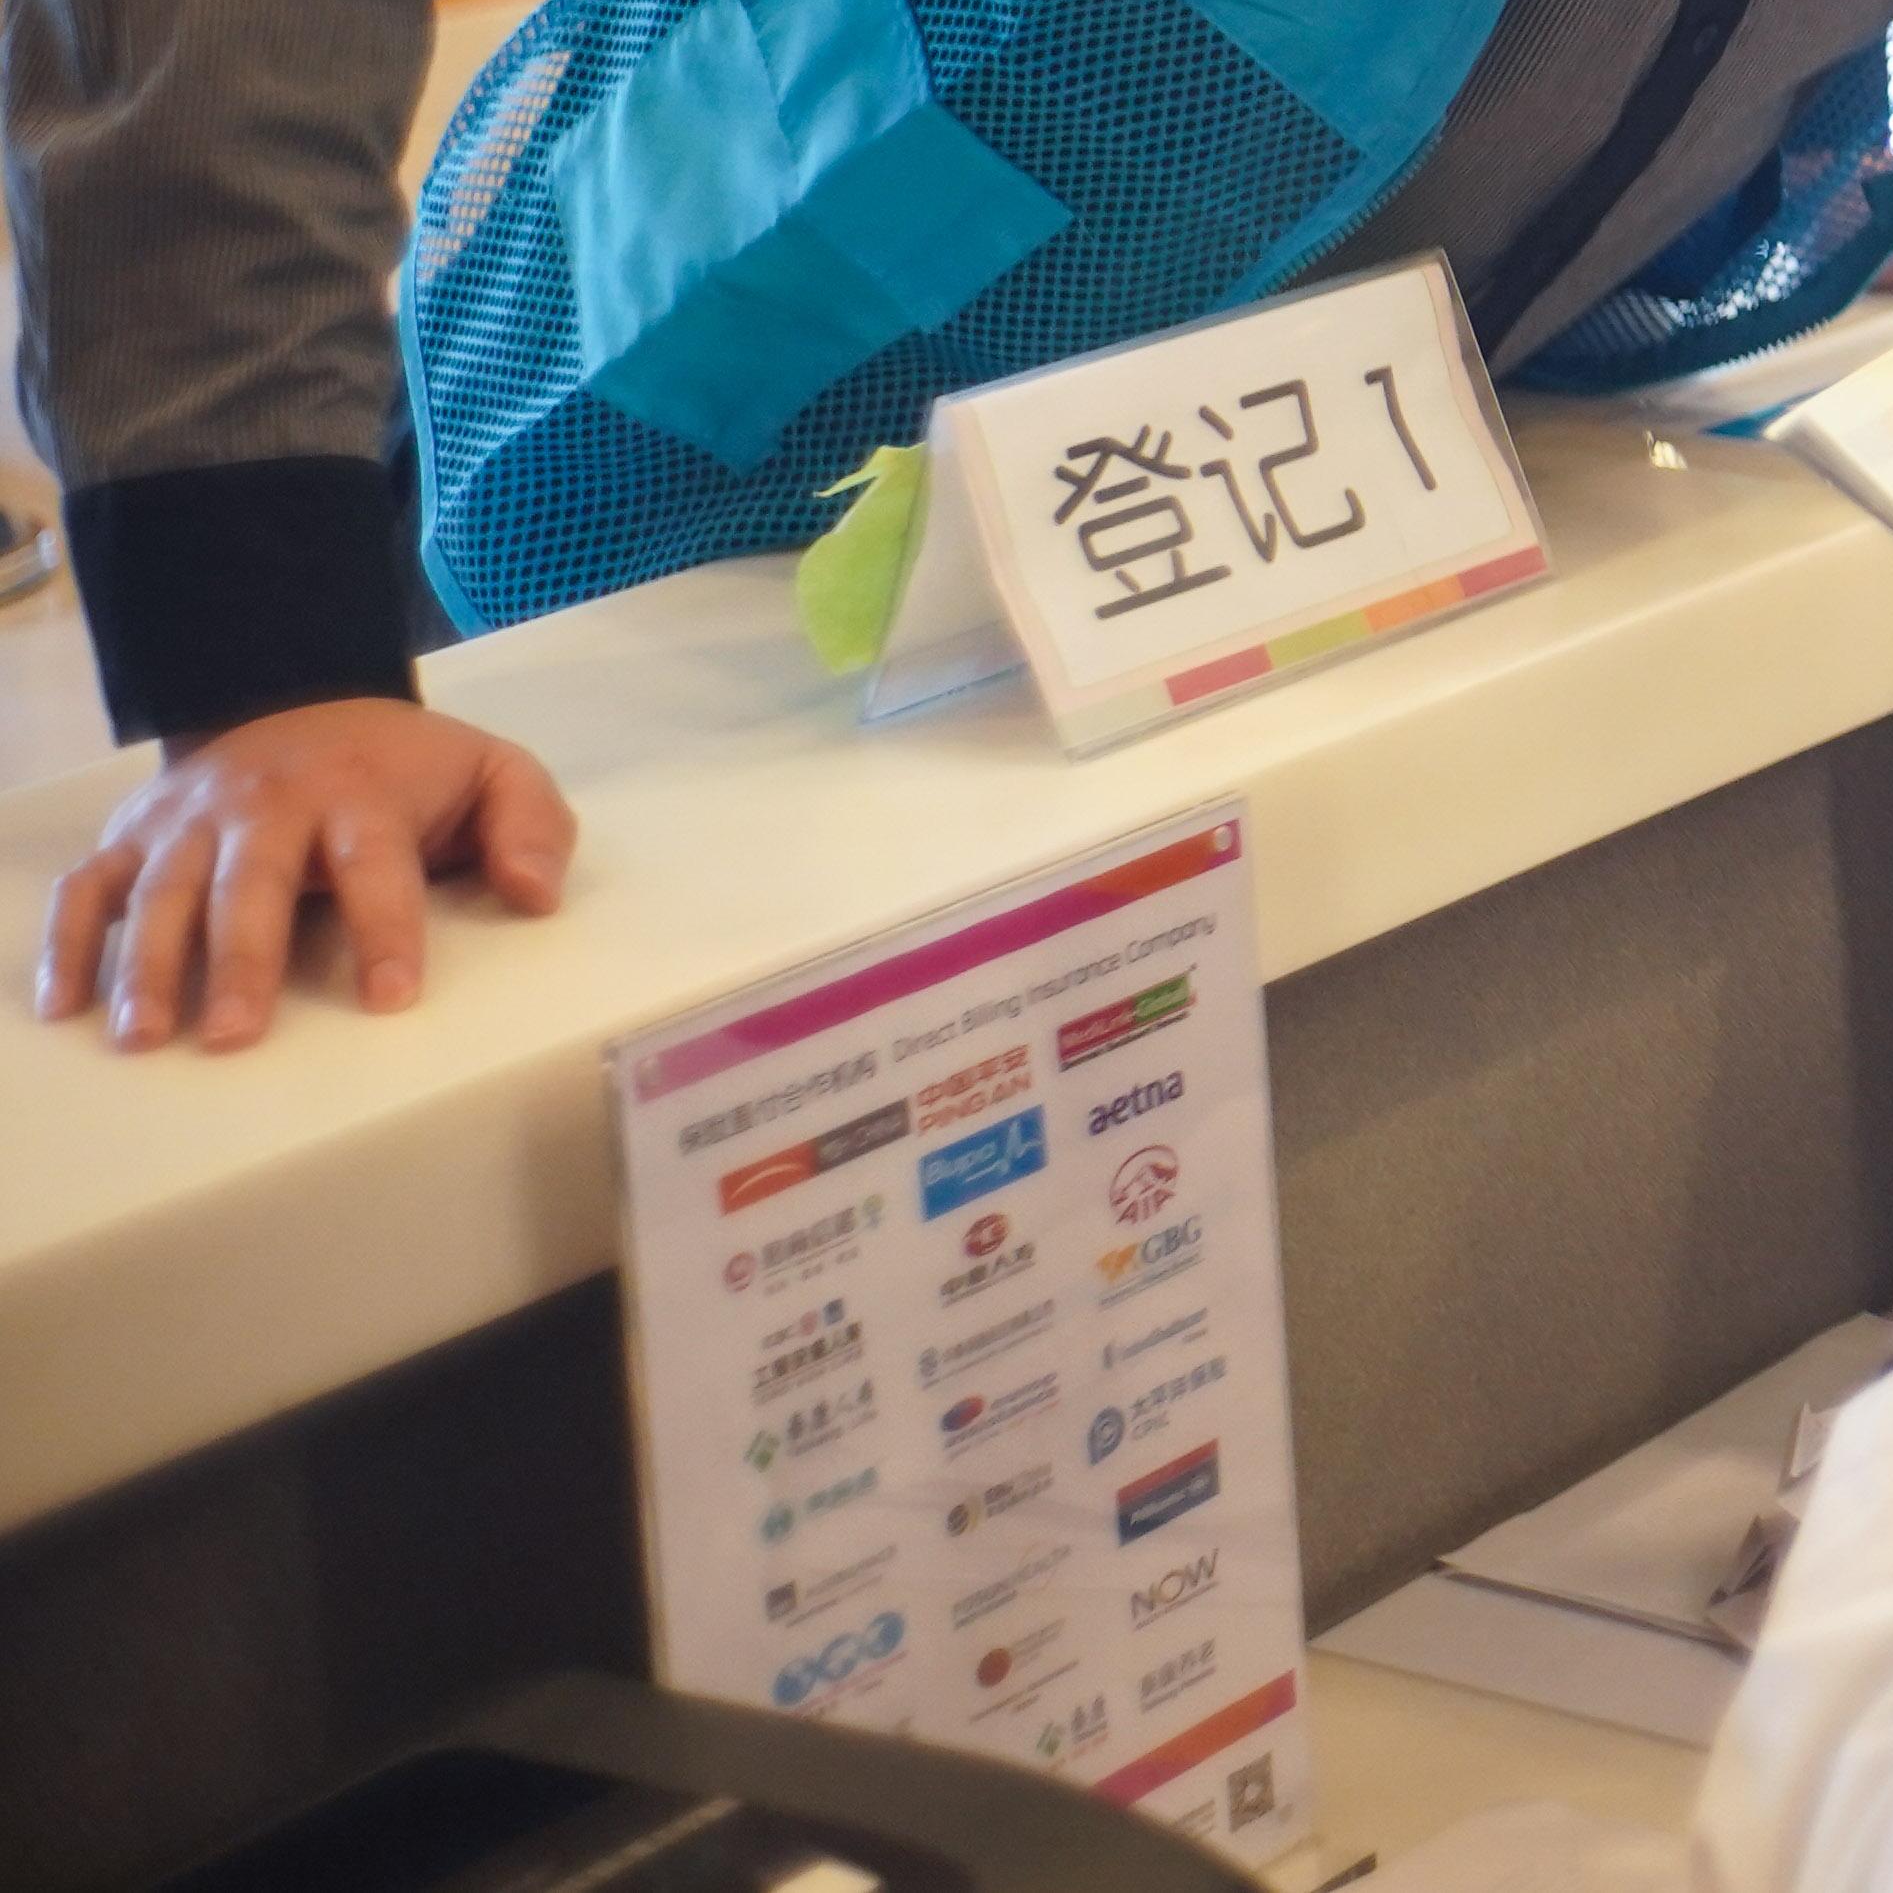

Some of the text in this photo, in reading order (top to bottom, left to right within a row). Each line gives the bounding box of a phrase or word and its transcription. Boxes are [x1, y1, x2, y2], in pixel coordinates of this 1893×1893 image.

[960, 993, 1022, 1034] Billing
[1026, 952, 1122, 1005] Insurance
[1124, 914, 1217, 964] Company
[1088, 1069, 1186, 1137] aetna
[1141, 1213, 1202, 1264] GBG
[1130, 1547, 1219, 1620] NOW
